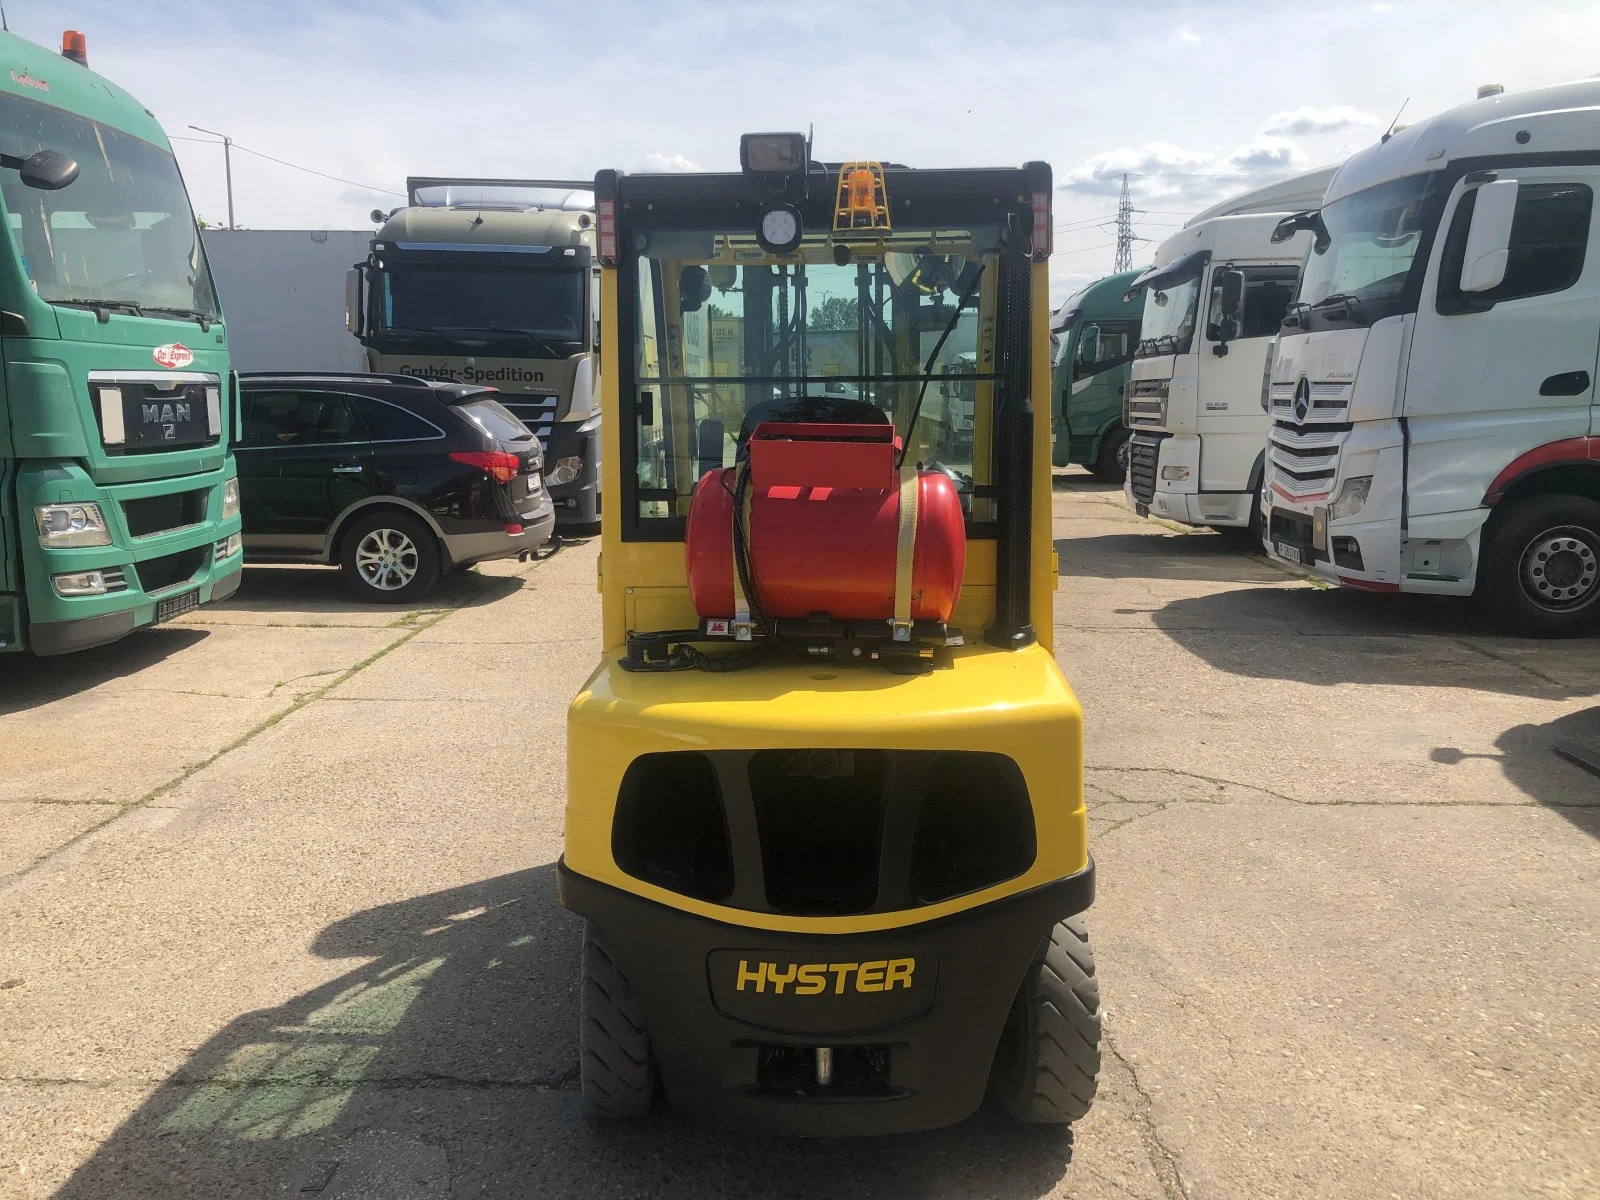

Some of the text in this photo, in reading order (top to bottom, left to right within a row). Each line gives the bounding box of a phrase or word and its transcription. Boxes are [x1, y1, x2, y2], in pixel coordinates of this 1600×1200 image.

[170, 349, 191, 362] Express
[142, 403, 191, 423] MAN
[737, 957, 914, 995] HYSTER
